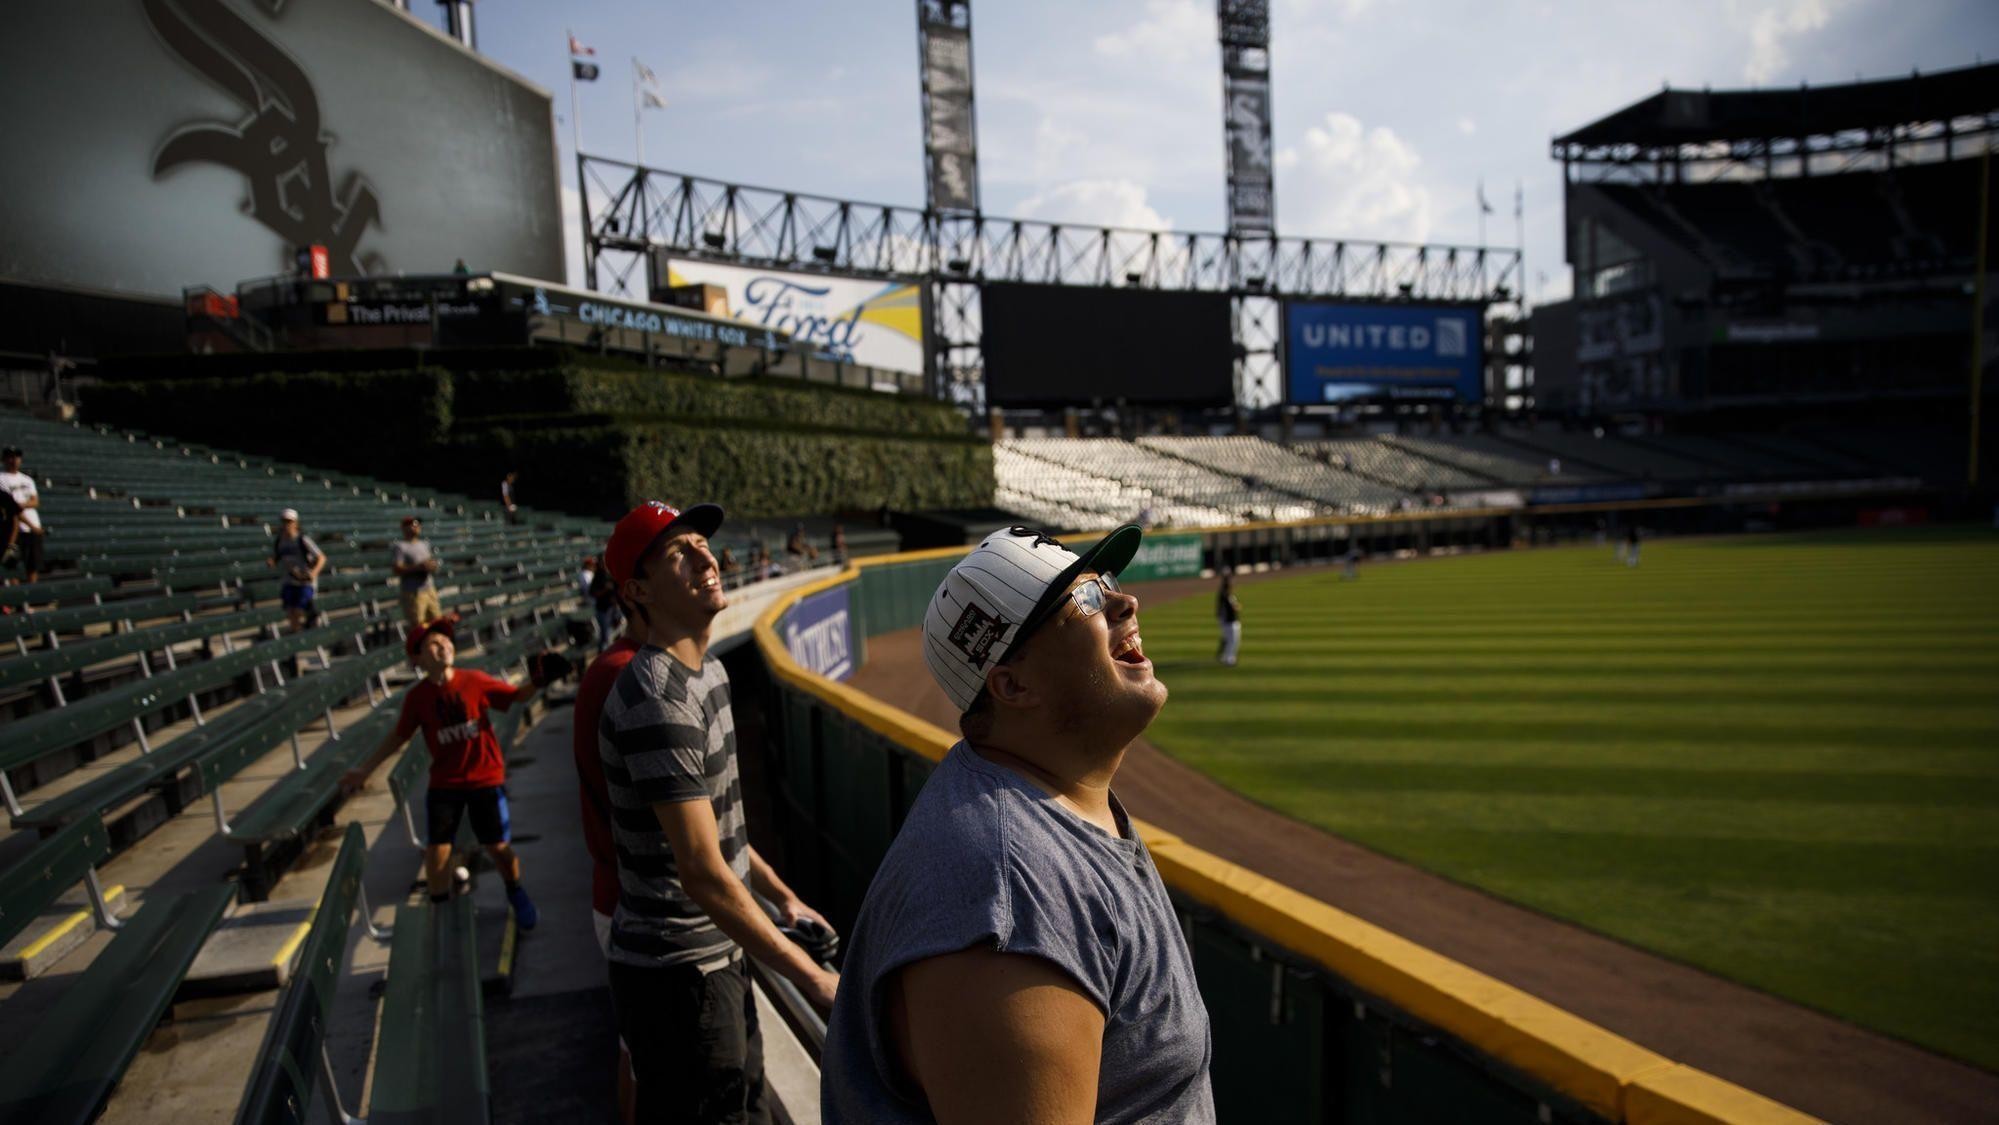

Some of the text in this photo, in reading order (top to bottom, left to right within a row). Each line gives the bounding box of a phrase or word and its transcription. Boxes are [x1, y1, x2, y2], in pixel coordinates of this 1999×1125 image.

[351, 304, 382, 323] The
[579, 302, 660, 332] CHICAGO
[664, 316, 714, 340] WHITE
[717, 326, 748, 347] SOX
[742, 276, 865, 348] Ford
[1302, 323, 1431, 349] UNITED
